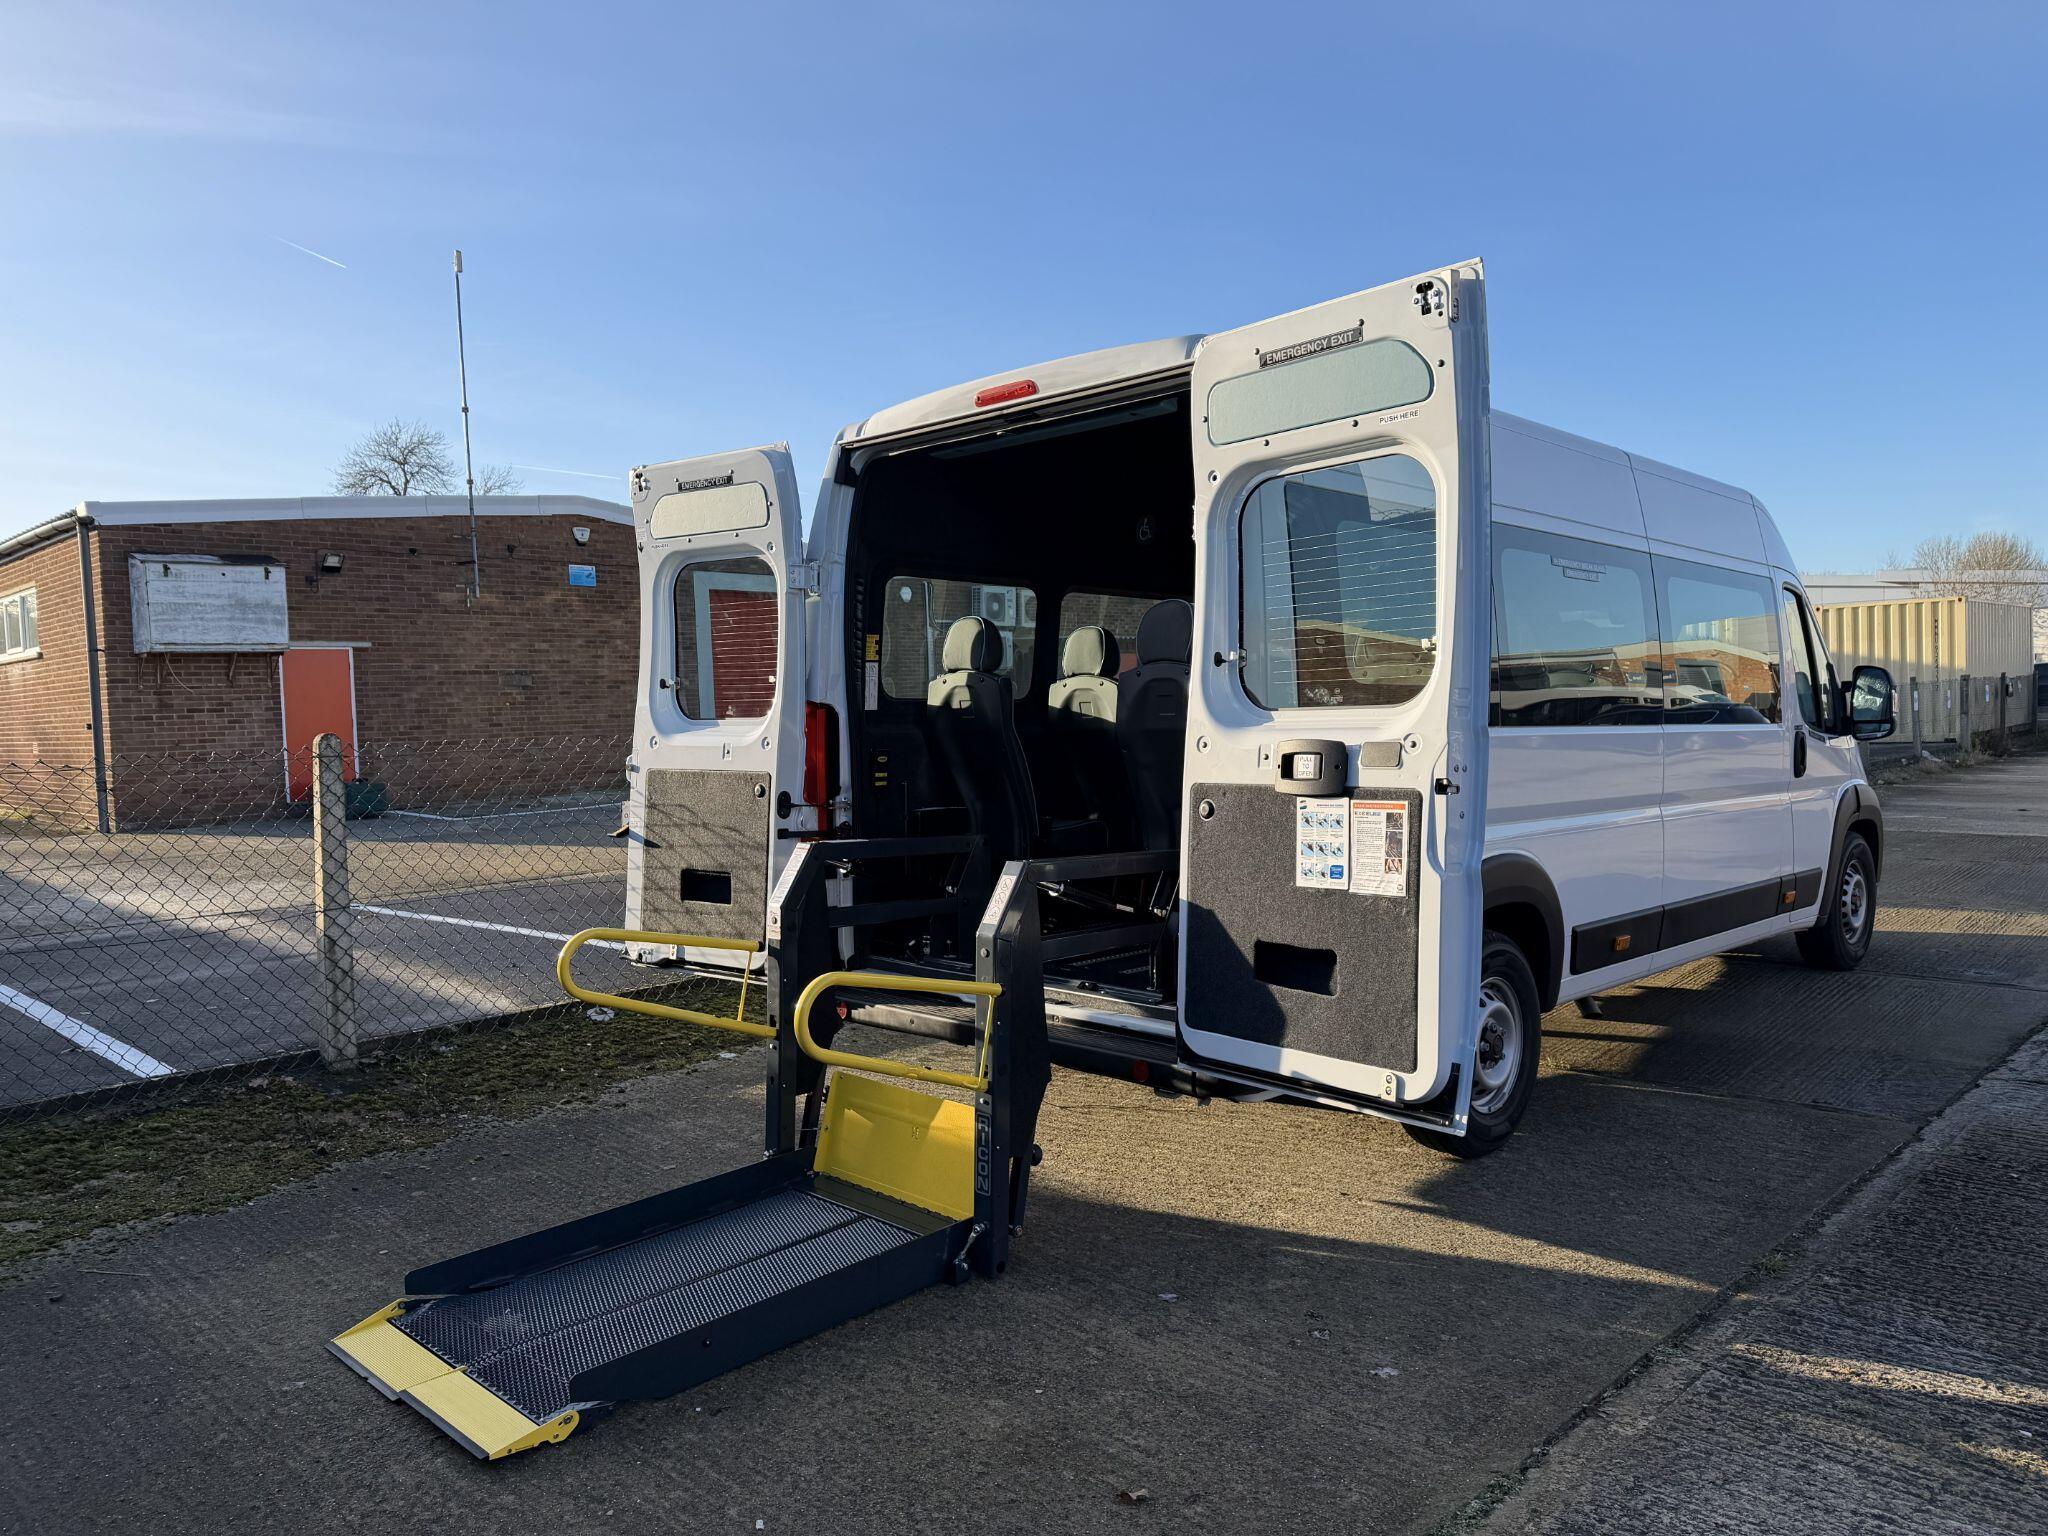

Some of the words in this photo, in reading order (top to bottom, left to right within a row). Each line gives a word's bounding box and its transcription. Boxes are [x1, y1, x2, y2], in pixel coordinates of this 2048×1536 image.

[1266, 338, 1328, 364] EMERGENCY
[1331, 331, 1354, 346] EXIT
[1379, 415, 1398, 423] PUSH
[1399, 410, 1419, 419] HERE
[681, 478, 715, 490] EMERGENCY
[716, 476, 728, 485] EXIT
[977, 1116, 989, 1192] RICON
